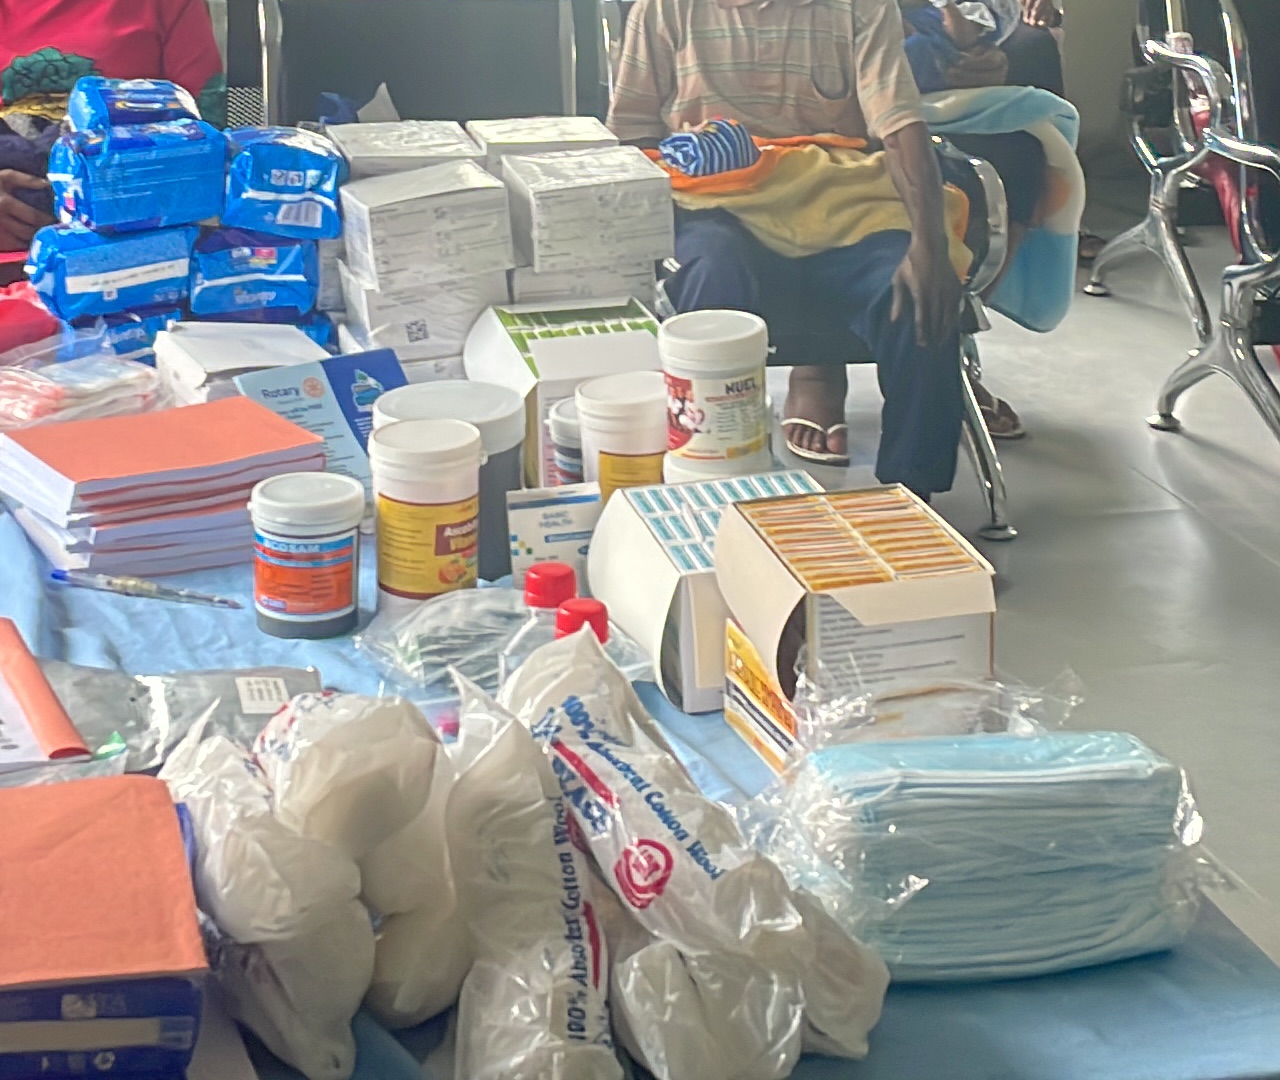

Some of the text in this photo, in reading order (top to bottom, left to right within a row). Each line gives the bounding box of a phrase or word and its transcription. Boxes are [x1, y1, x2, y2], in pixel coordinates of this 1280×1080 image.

[261, 387, 300, 399] Rotary
[548, 795, 571, 847] Wool
[644, 791, 690, 842] Cotton
[686, 839, 726, 881] Wool
[558, 852, 582, 910] Cotton
